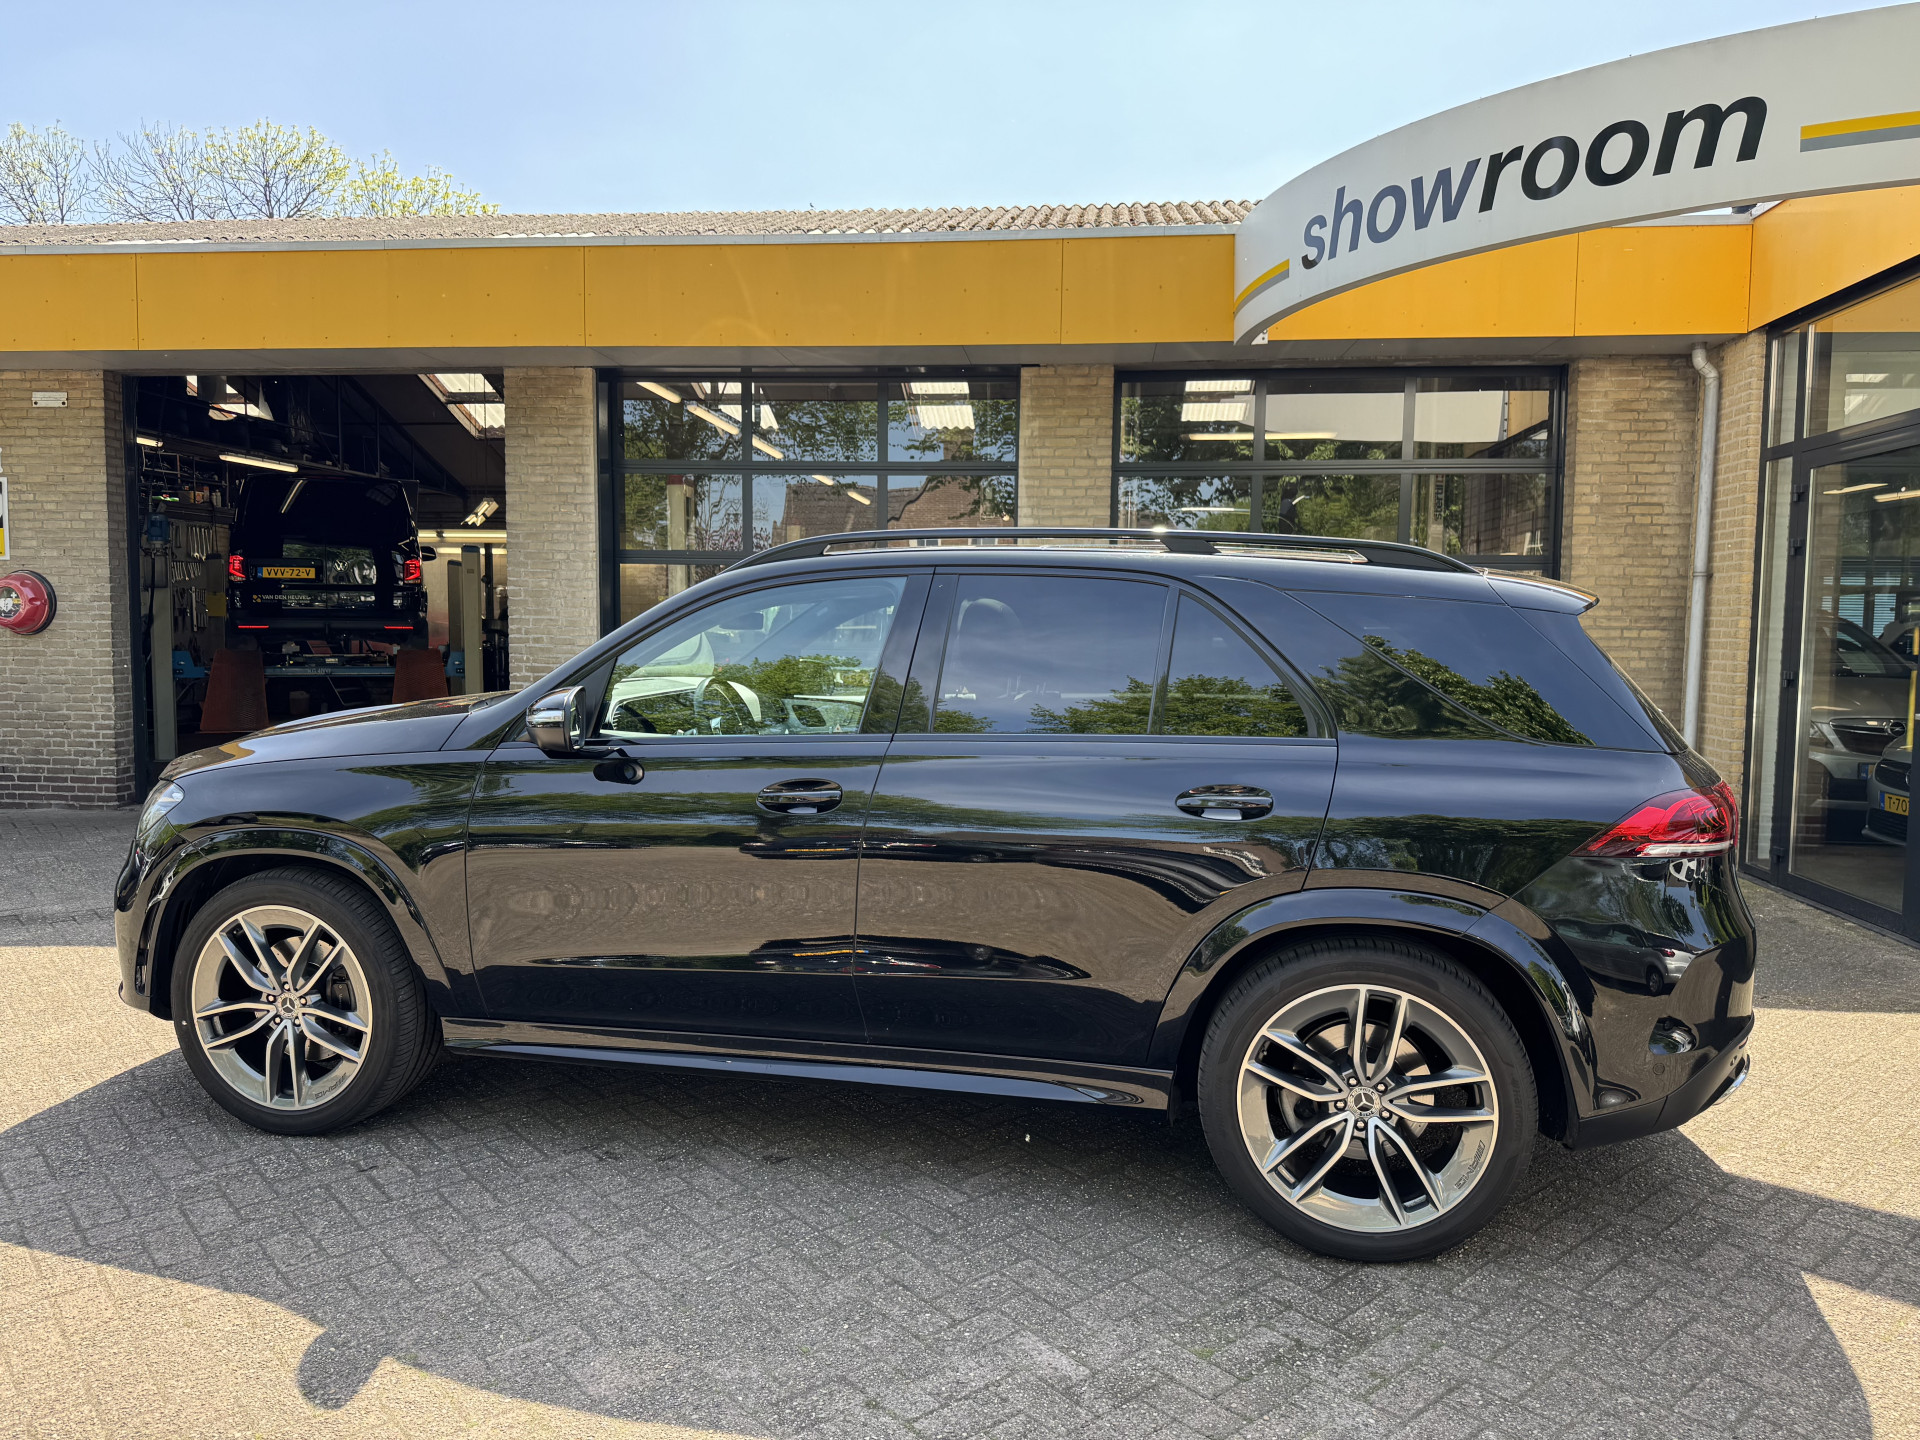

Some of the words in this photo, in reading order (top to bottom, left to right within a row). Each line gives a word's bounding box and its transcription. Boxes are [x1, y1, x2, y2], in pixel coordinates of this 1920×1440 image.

[1301, 95, 1768, 271] showroom
[266, 568, 311, 577] VVV-72-V
[1888, 797, 1909, 813] T-70
